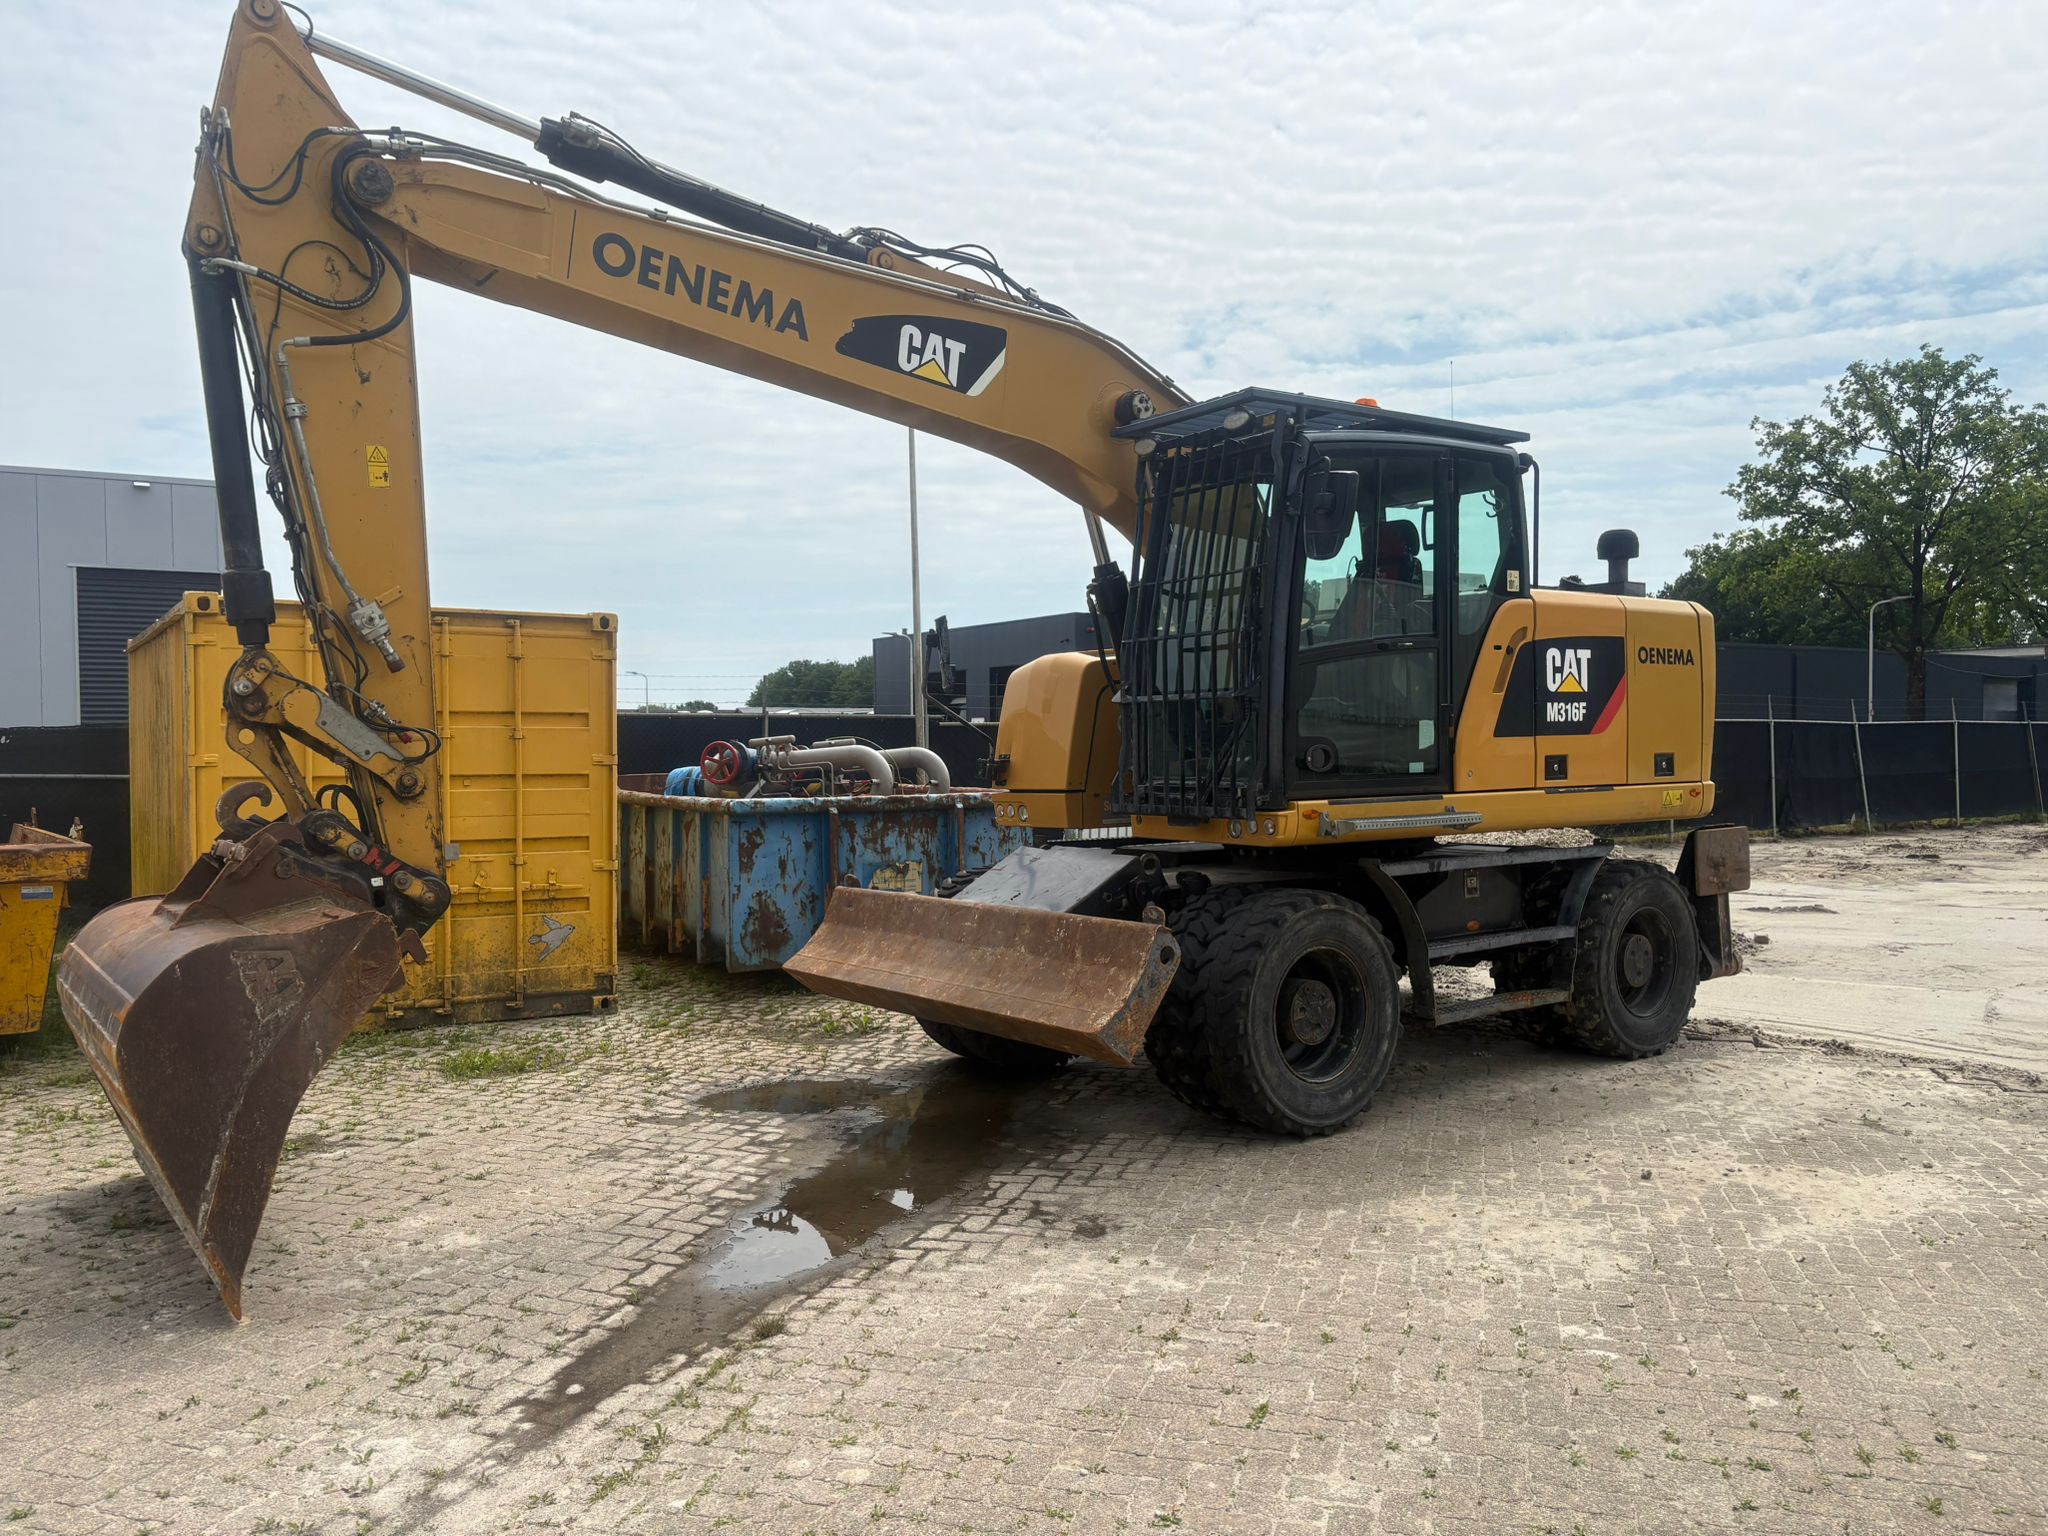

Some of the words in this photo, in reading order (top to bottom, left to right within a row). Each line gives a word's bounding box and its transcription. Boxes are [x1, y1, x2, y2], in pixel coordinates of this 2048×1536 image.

[593, 233, 809, 342] OENEMA
[898, 324, 966, 387] CAT
[1546, 647, 1592, 693] CAT
[1637, 646, 1695, 666] OENEMA
[1546, 701, 1587, 722] M316F
